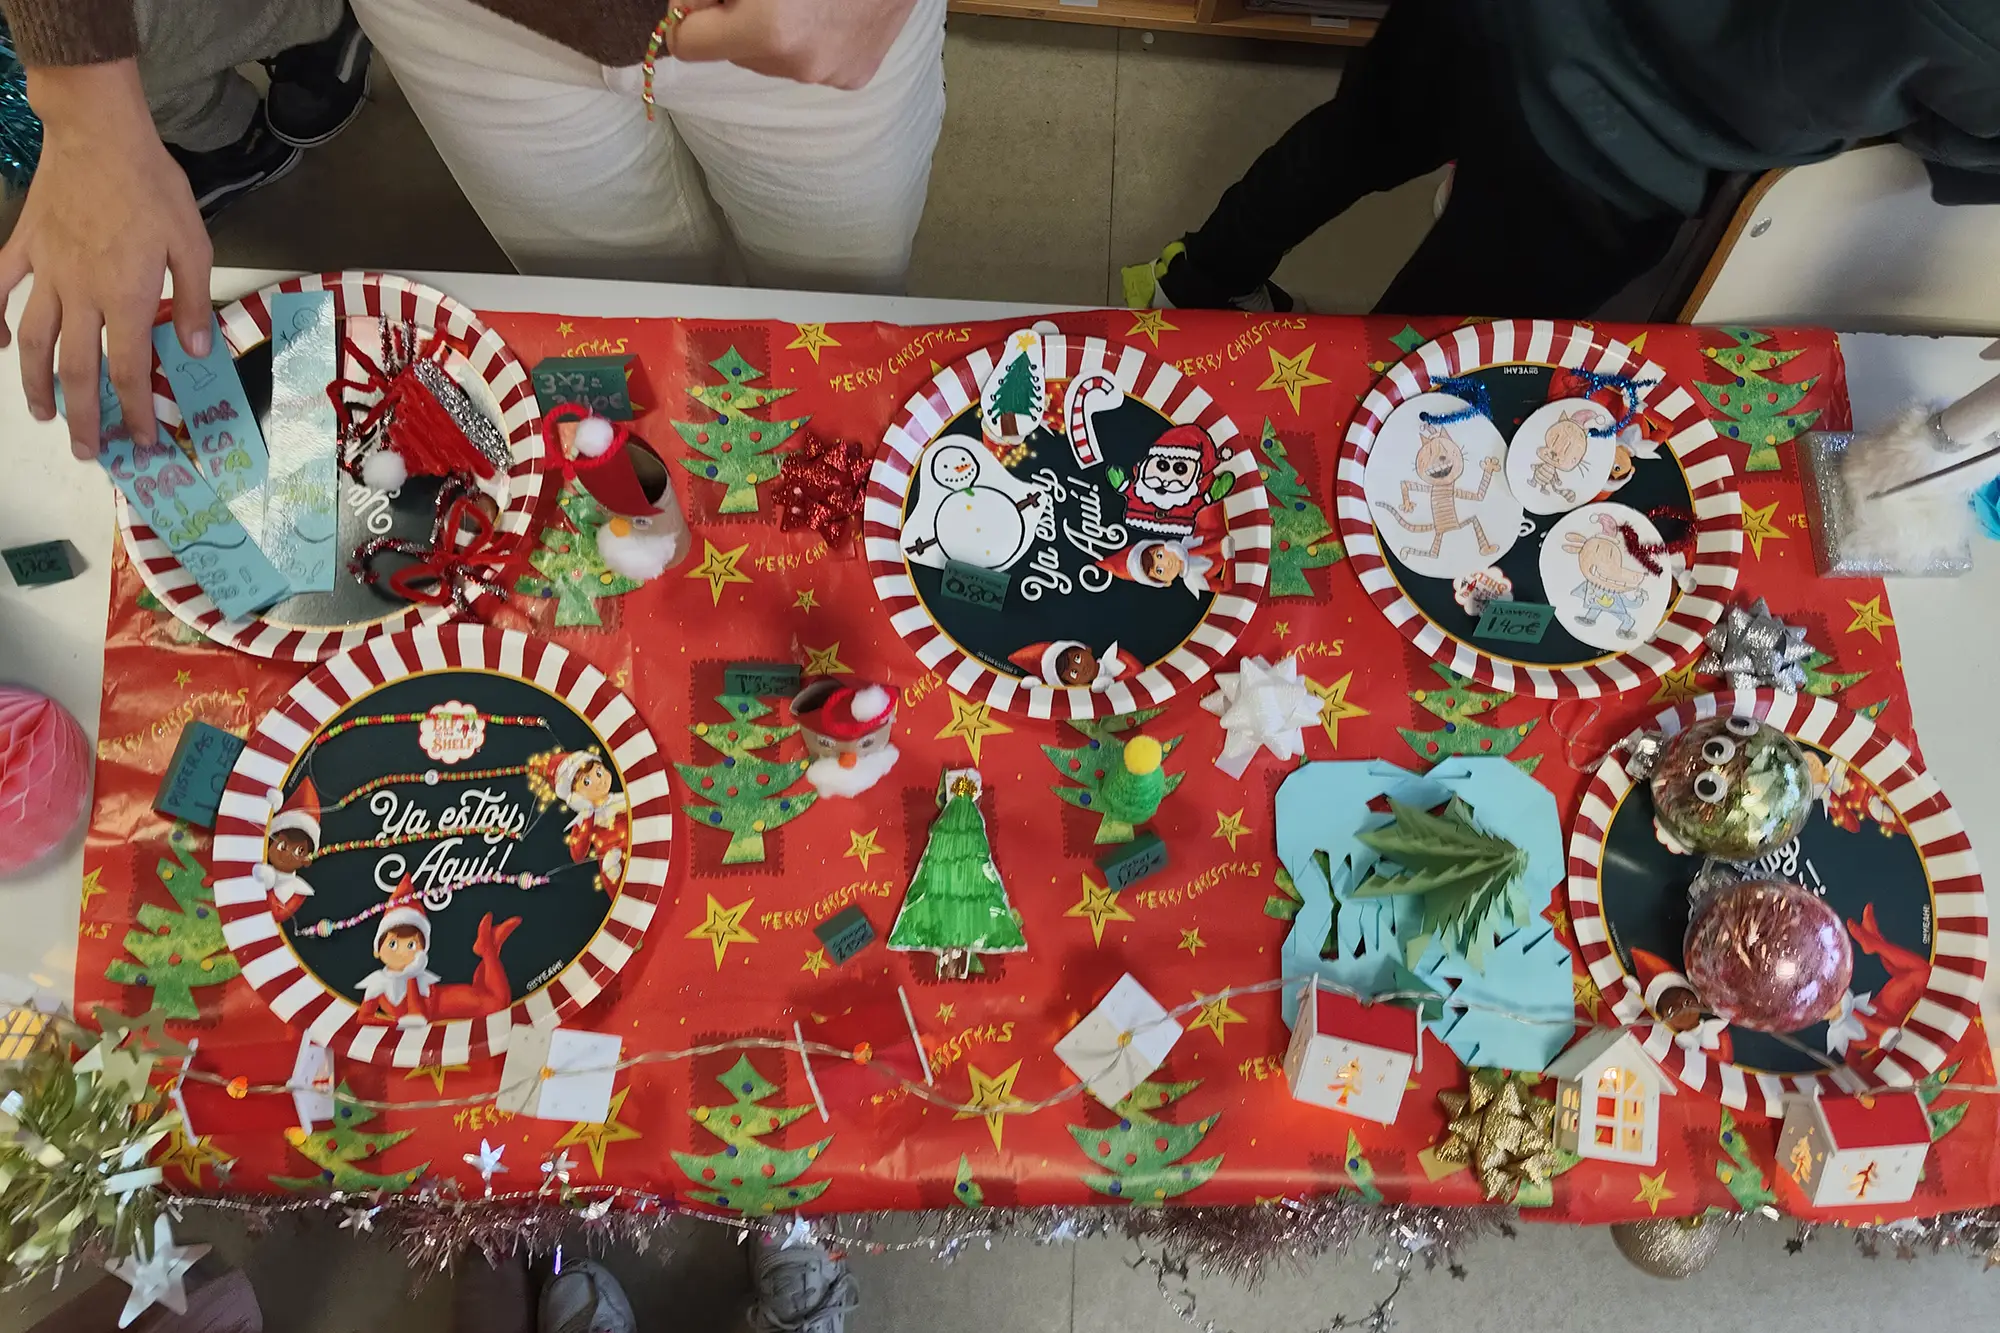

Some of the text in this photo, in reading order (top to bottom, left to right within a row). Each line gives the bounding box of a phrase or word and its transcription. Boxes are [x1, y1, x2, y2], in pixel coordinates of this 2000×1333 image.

[829, 328, 972, 393] MERRY CHRISTMAS
[1227, 318, 1307, 362] CHRISTMAS
[755, 552, 801, 574] MERRY
[1020, 546, 1073, 602] Ya
[370, 790, 431, 847] Ya
[761, 880, 893, 931] MERRY CHRISTMAS
[1135, 884, 1184, 909] MERRY
[1187, 861, 1261, 899] CHRISTMAS
[929, 1022, 1015, 1077] HRISTMAS
